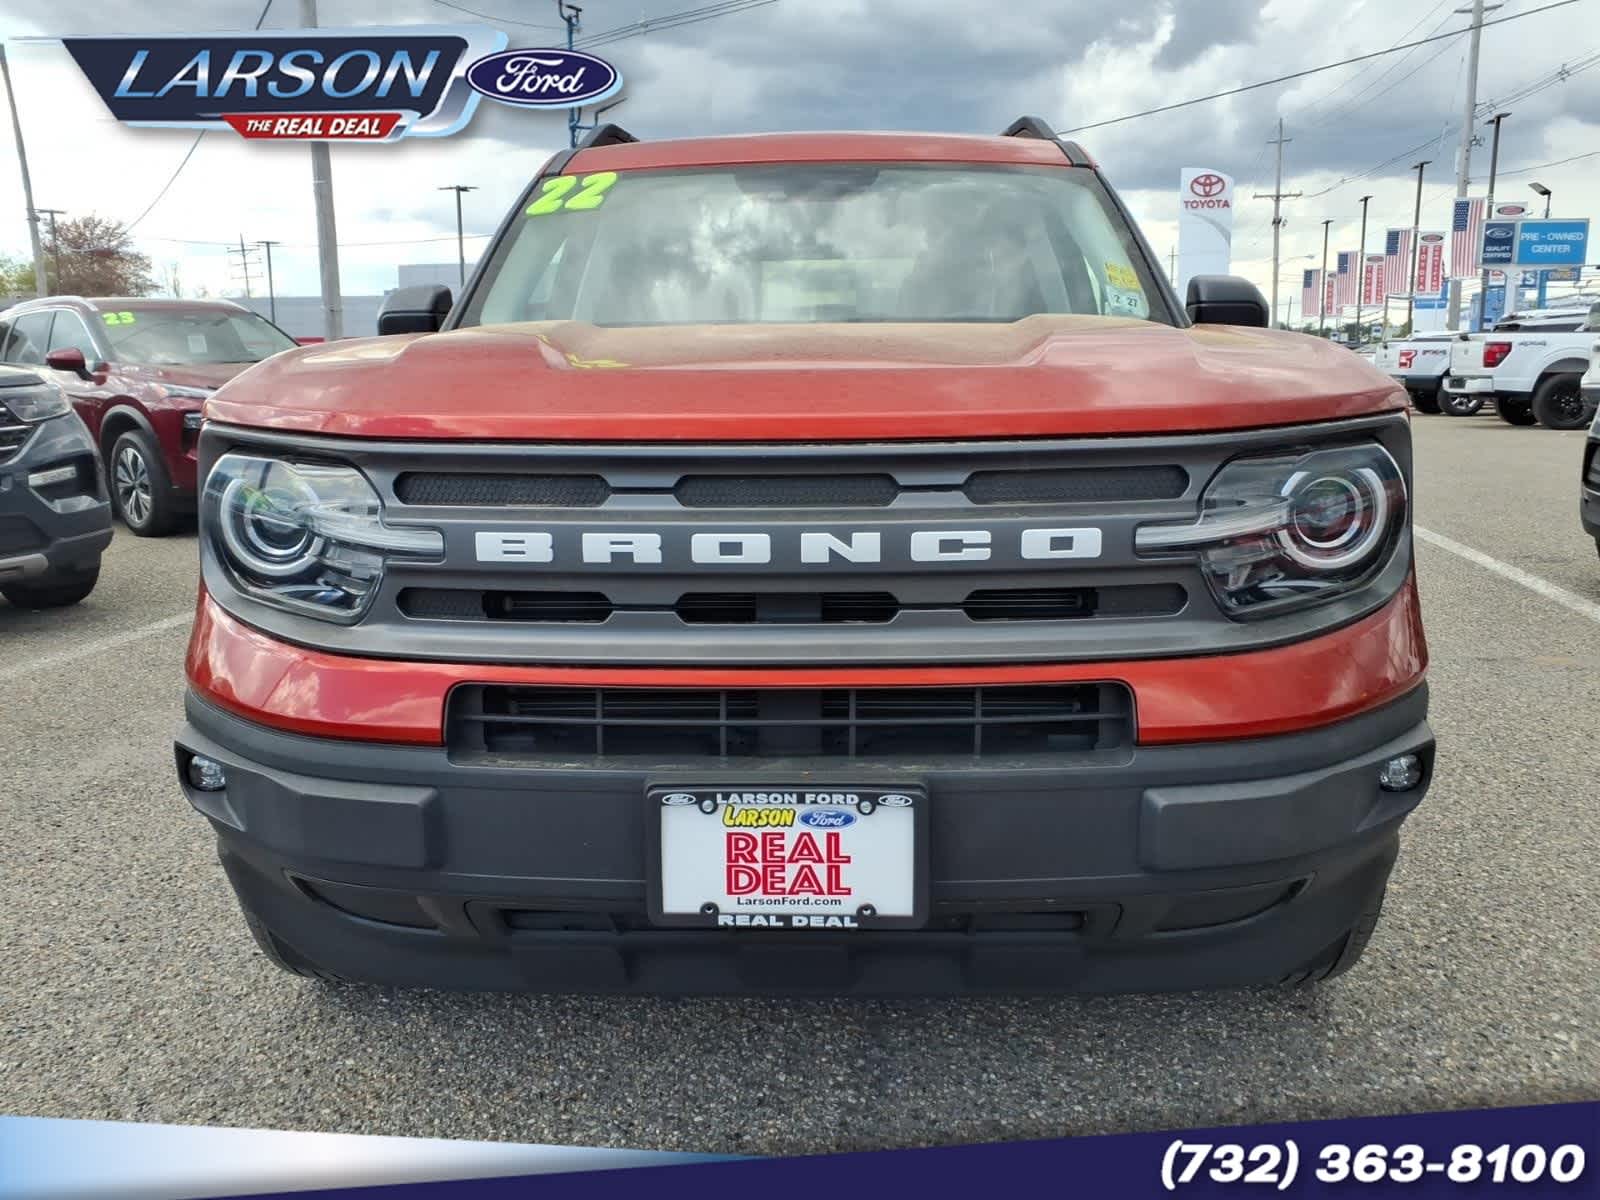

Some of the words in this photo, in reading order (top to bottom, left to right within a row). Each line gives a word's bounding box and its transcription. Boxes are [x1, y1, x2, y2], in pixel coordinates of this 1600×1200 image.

[525, 171, 617, 216] 22
[1183, 199, 1230, 209] TOYOTA
[1531, 244, 1570, 253] CENTER
[103, 311, 135, 326] 23
[474, 527, 1103, 564] BRONCO
[716, 792, 797, 804] LARSON
[805, 793, 859, 805] FORD
[722, 804, 796, 828] LARSON
[725, 832, 852, 864] REAL
[725, 864, 852, 896] DEAL
[736, 896, 842, 907] LarsonFord.com
[718, 914, 784, 926] REAL
[791, 915, 858, 928] DEAL
